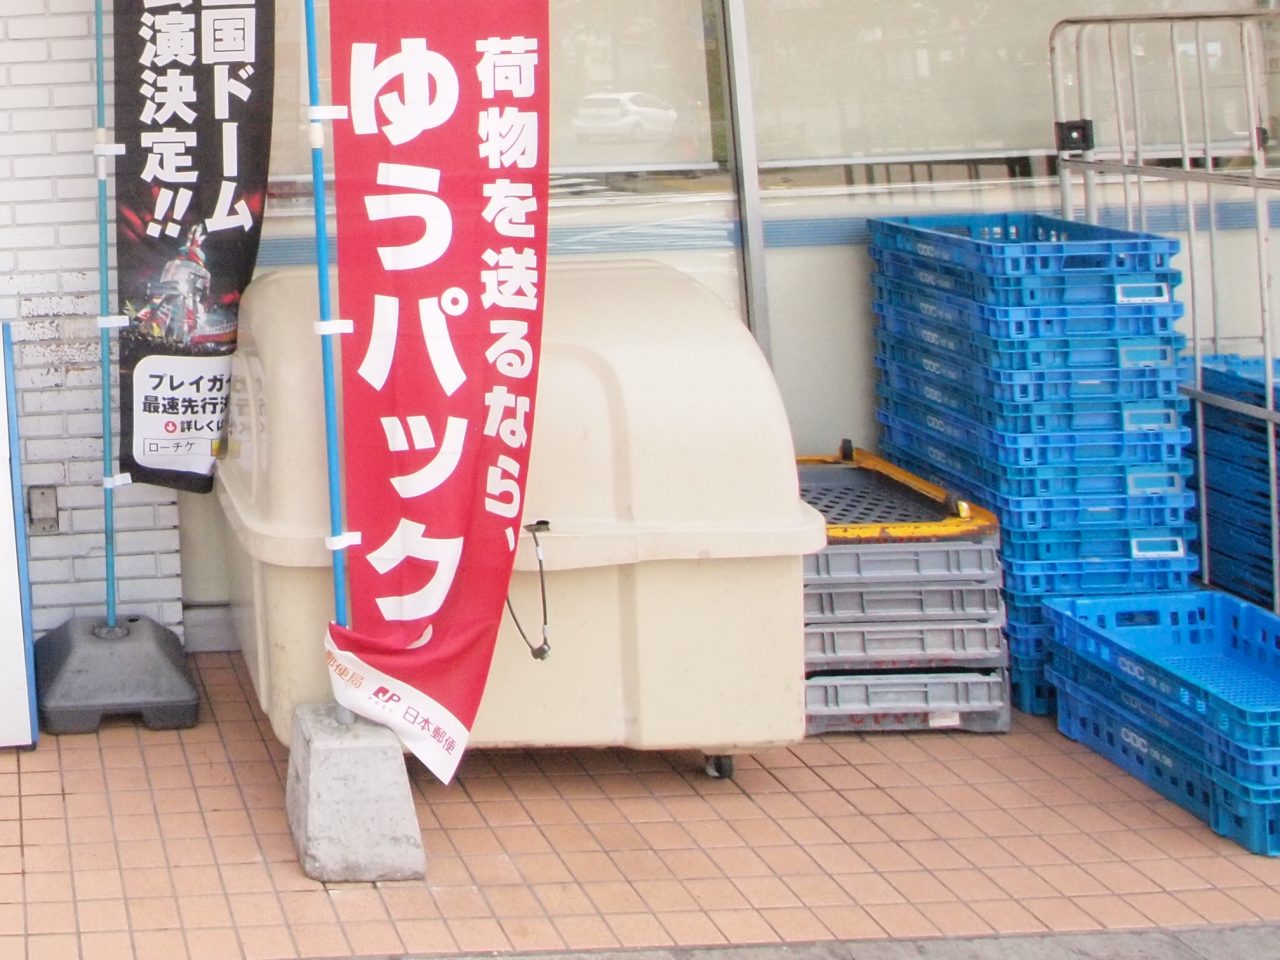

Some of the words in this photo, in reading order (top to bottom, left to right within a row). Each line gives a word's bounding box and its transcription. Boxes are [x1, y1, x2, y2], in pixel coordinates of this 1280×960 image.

[350, 38, 469, 622] ゆうパック
[476, 37, 539, 552] 荷物を送るなら、
[149, 440, 196, 453] ローチケ
[402, 706, 457, 756] 日本郵便
